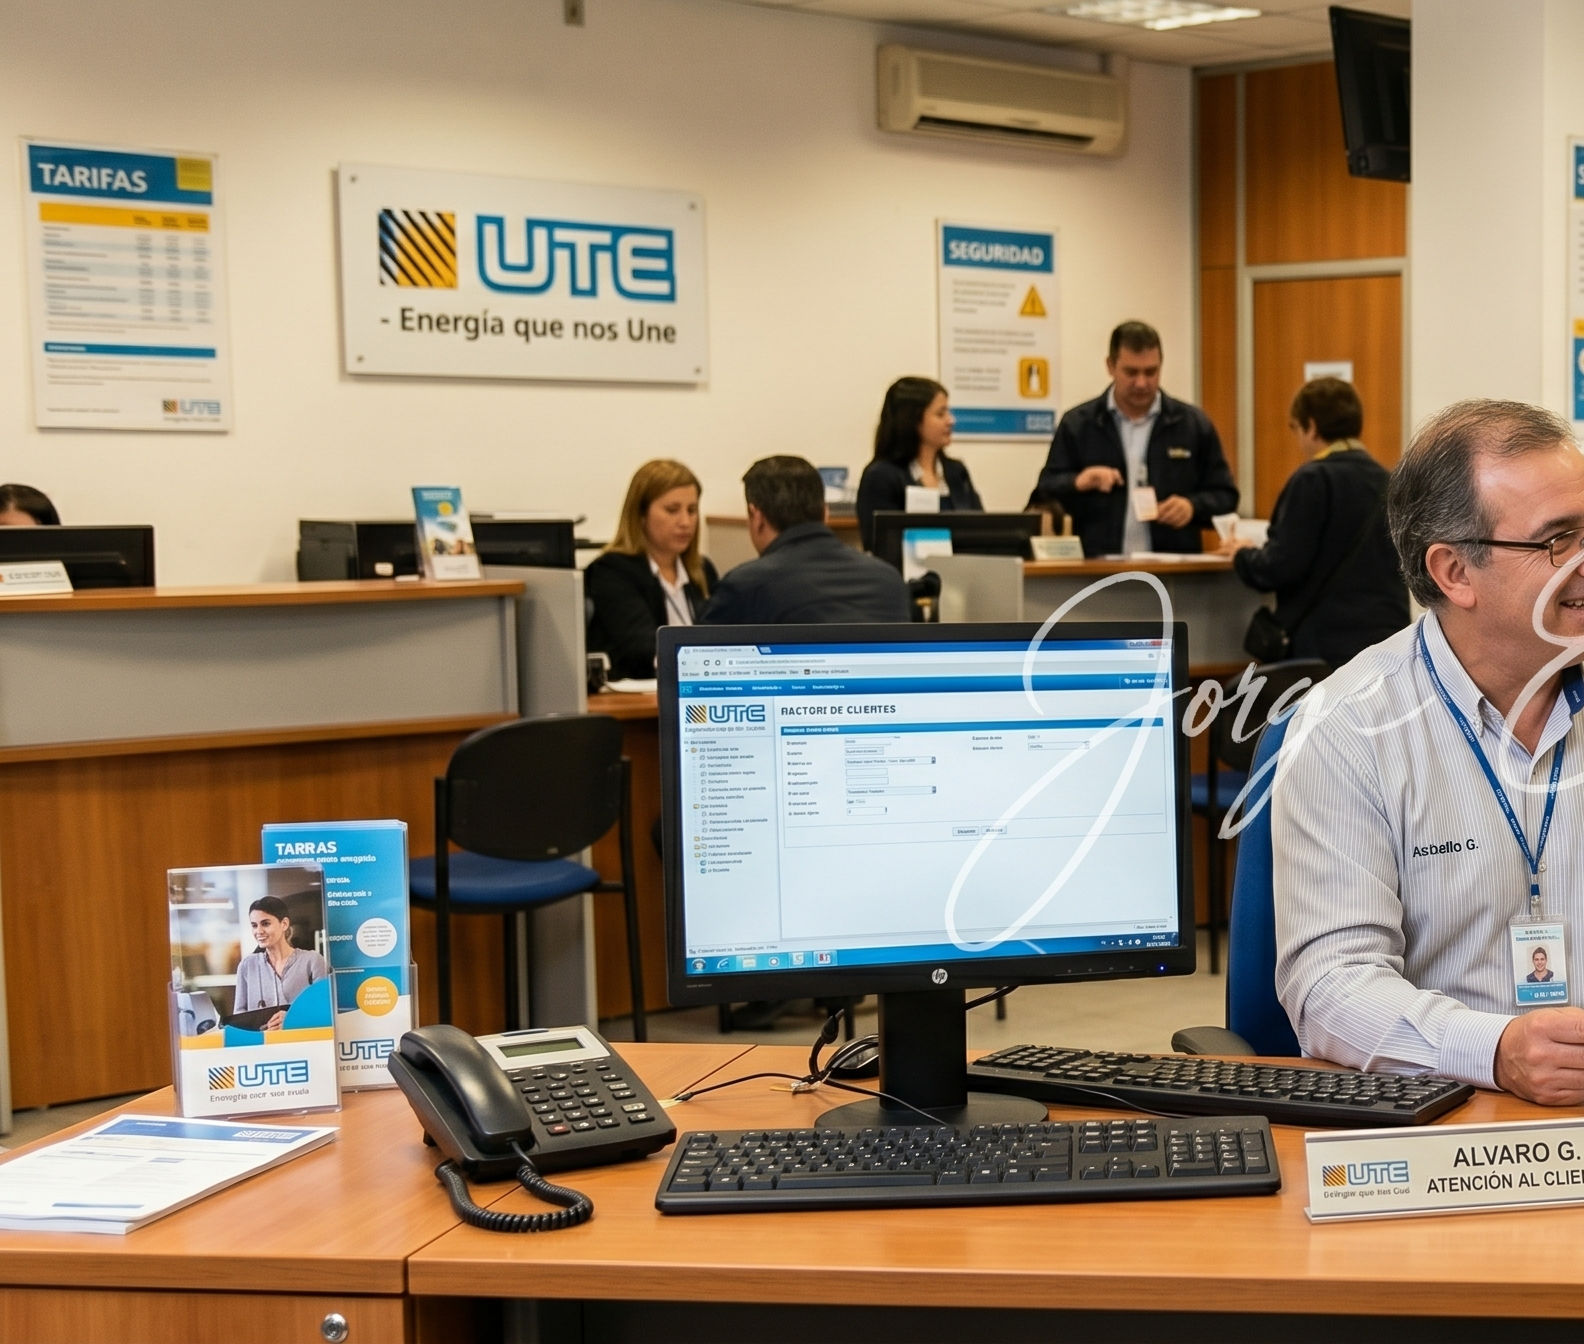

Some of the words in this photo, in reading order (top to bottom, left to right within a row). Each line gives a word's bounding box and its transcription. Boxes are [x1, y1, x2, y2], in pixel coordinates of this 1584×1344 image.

[37, 162, 149, 193] TARIFAS
[476, 214, 677, 303] UTE
[948, 239, 1045, 266] SEGURIDAD
[400, 307, 505, 341] Energía
[514, 318, 564, 343] que
[573, 320, 619, 341] nos
[628, 319, 677, 344] Une
[830, 706, 844, 715] DE
[275, 841, 337, 856] TARRAS
[1466, 838, 1479, 851] G.
[238, 1059, 309, 1088] UTE
[1453, 1142, 1550, 1168] ALVARO
[1557, 1140, 1581, 1162] G.
[1347, 1160, 1410, 1186] UTE
[1426, 1170, 1514, 1194] ATENCIÓN
[1518, 1172, 1540, 1188] AL
